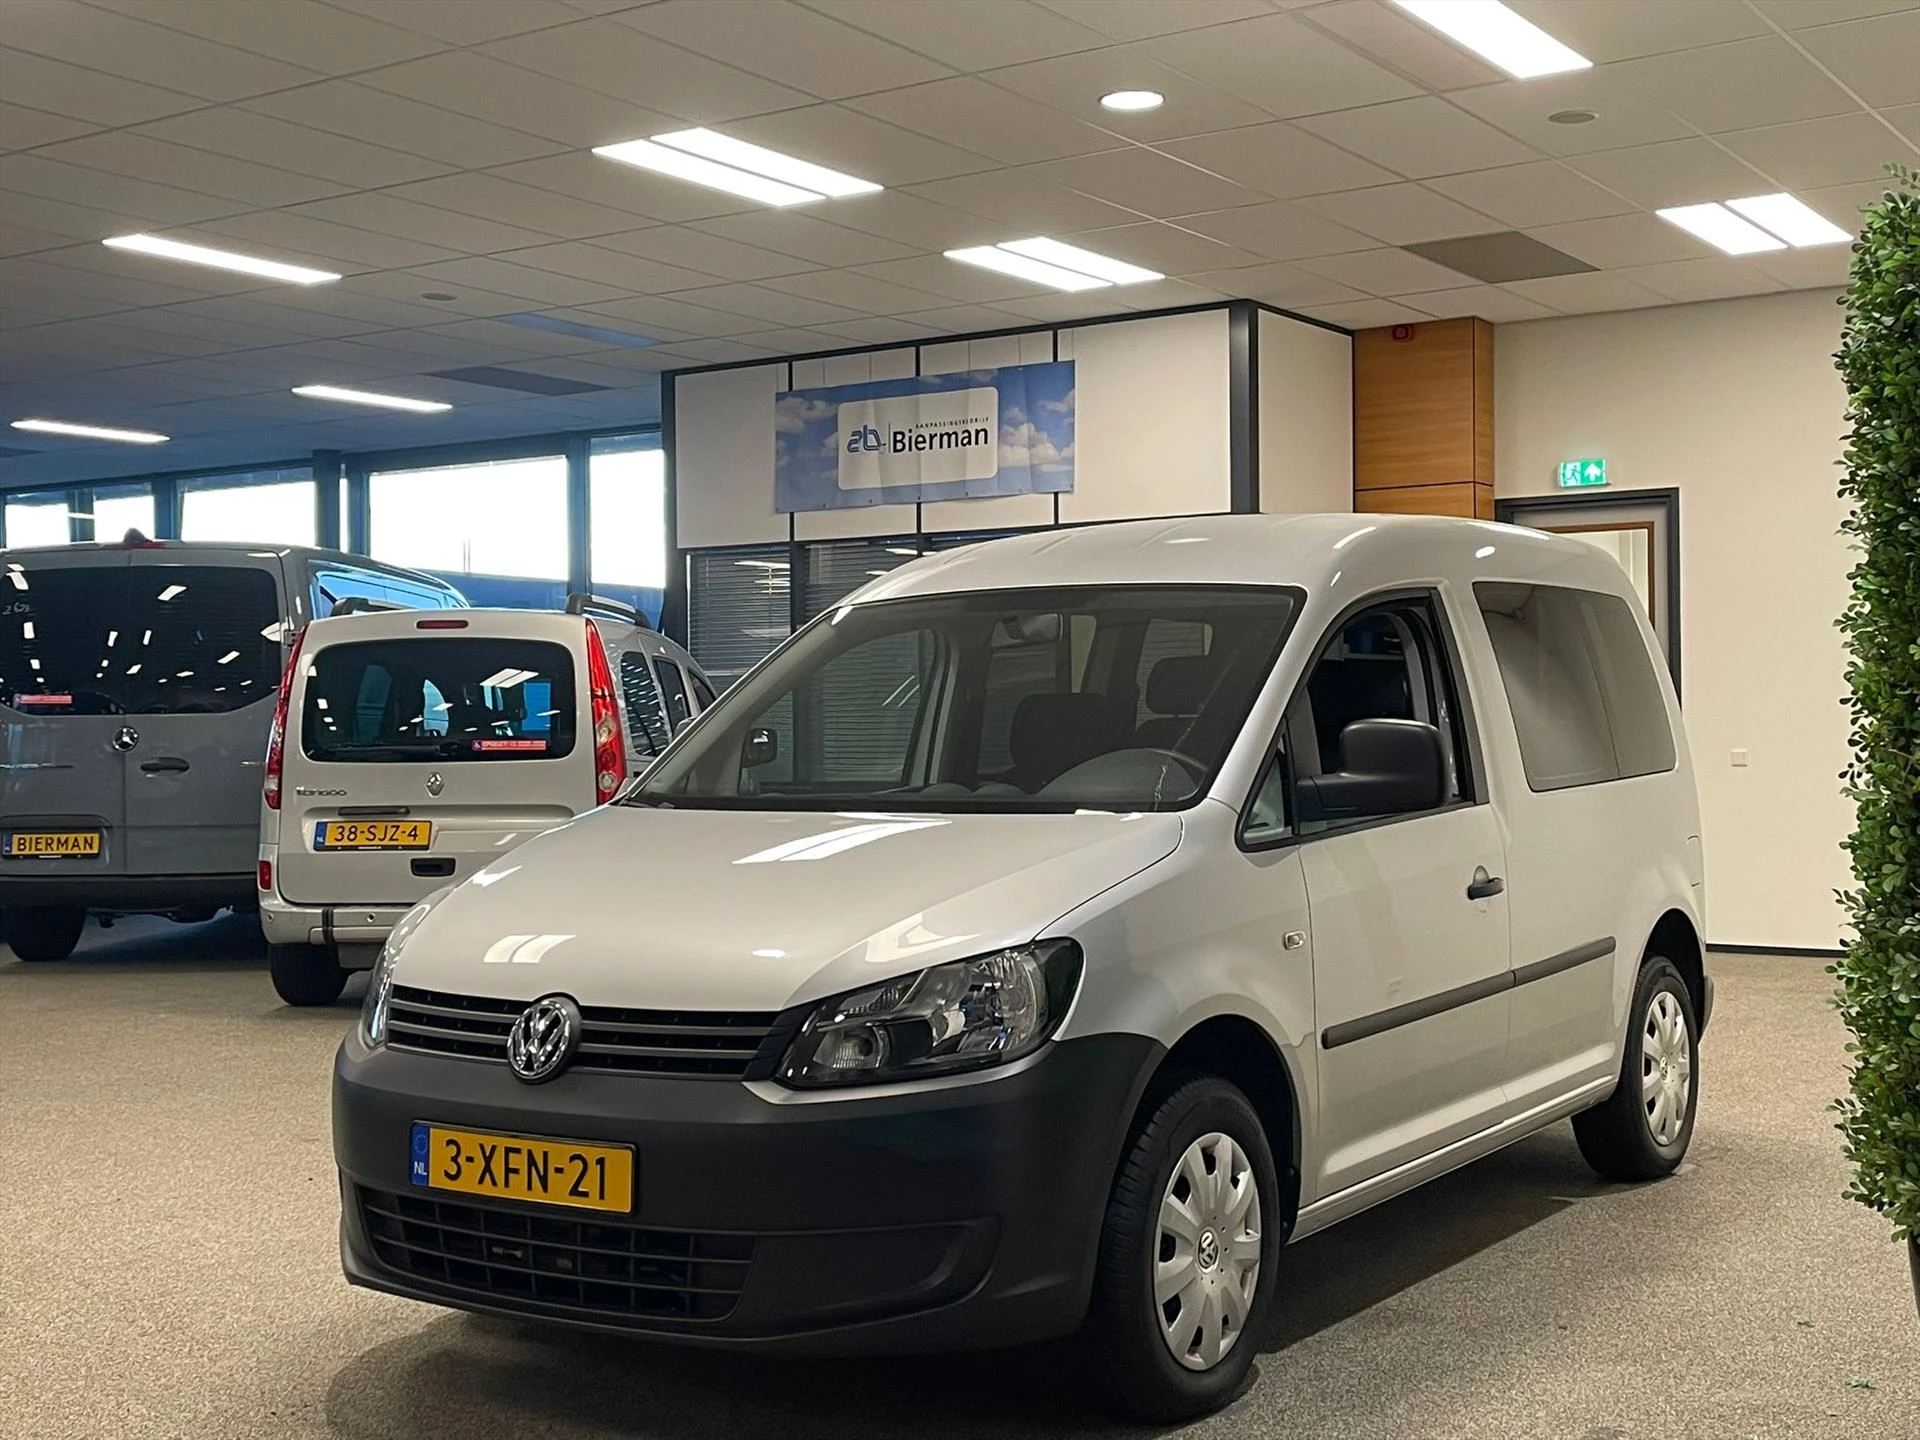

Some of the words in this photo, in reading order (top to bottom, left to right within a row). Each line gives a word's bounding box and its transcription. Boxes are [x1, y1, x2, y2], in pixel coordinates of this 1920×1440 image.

[892, 427, 989, 454] Bierman
[334, 824, 419, 842] 38-SJZ-4
[17, 835, 95, 852] BIERMAN
[413, 1161, 428, 1176] NL
[443, 1138, 607, 1200] 3-XFN-21
